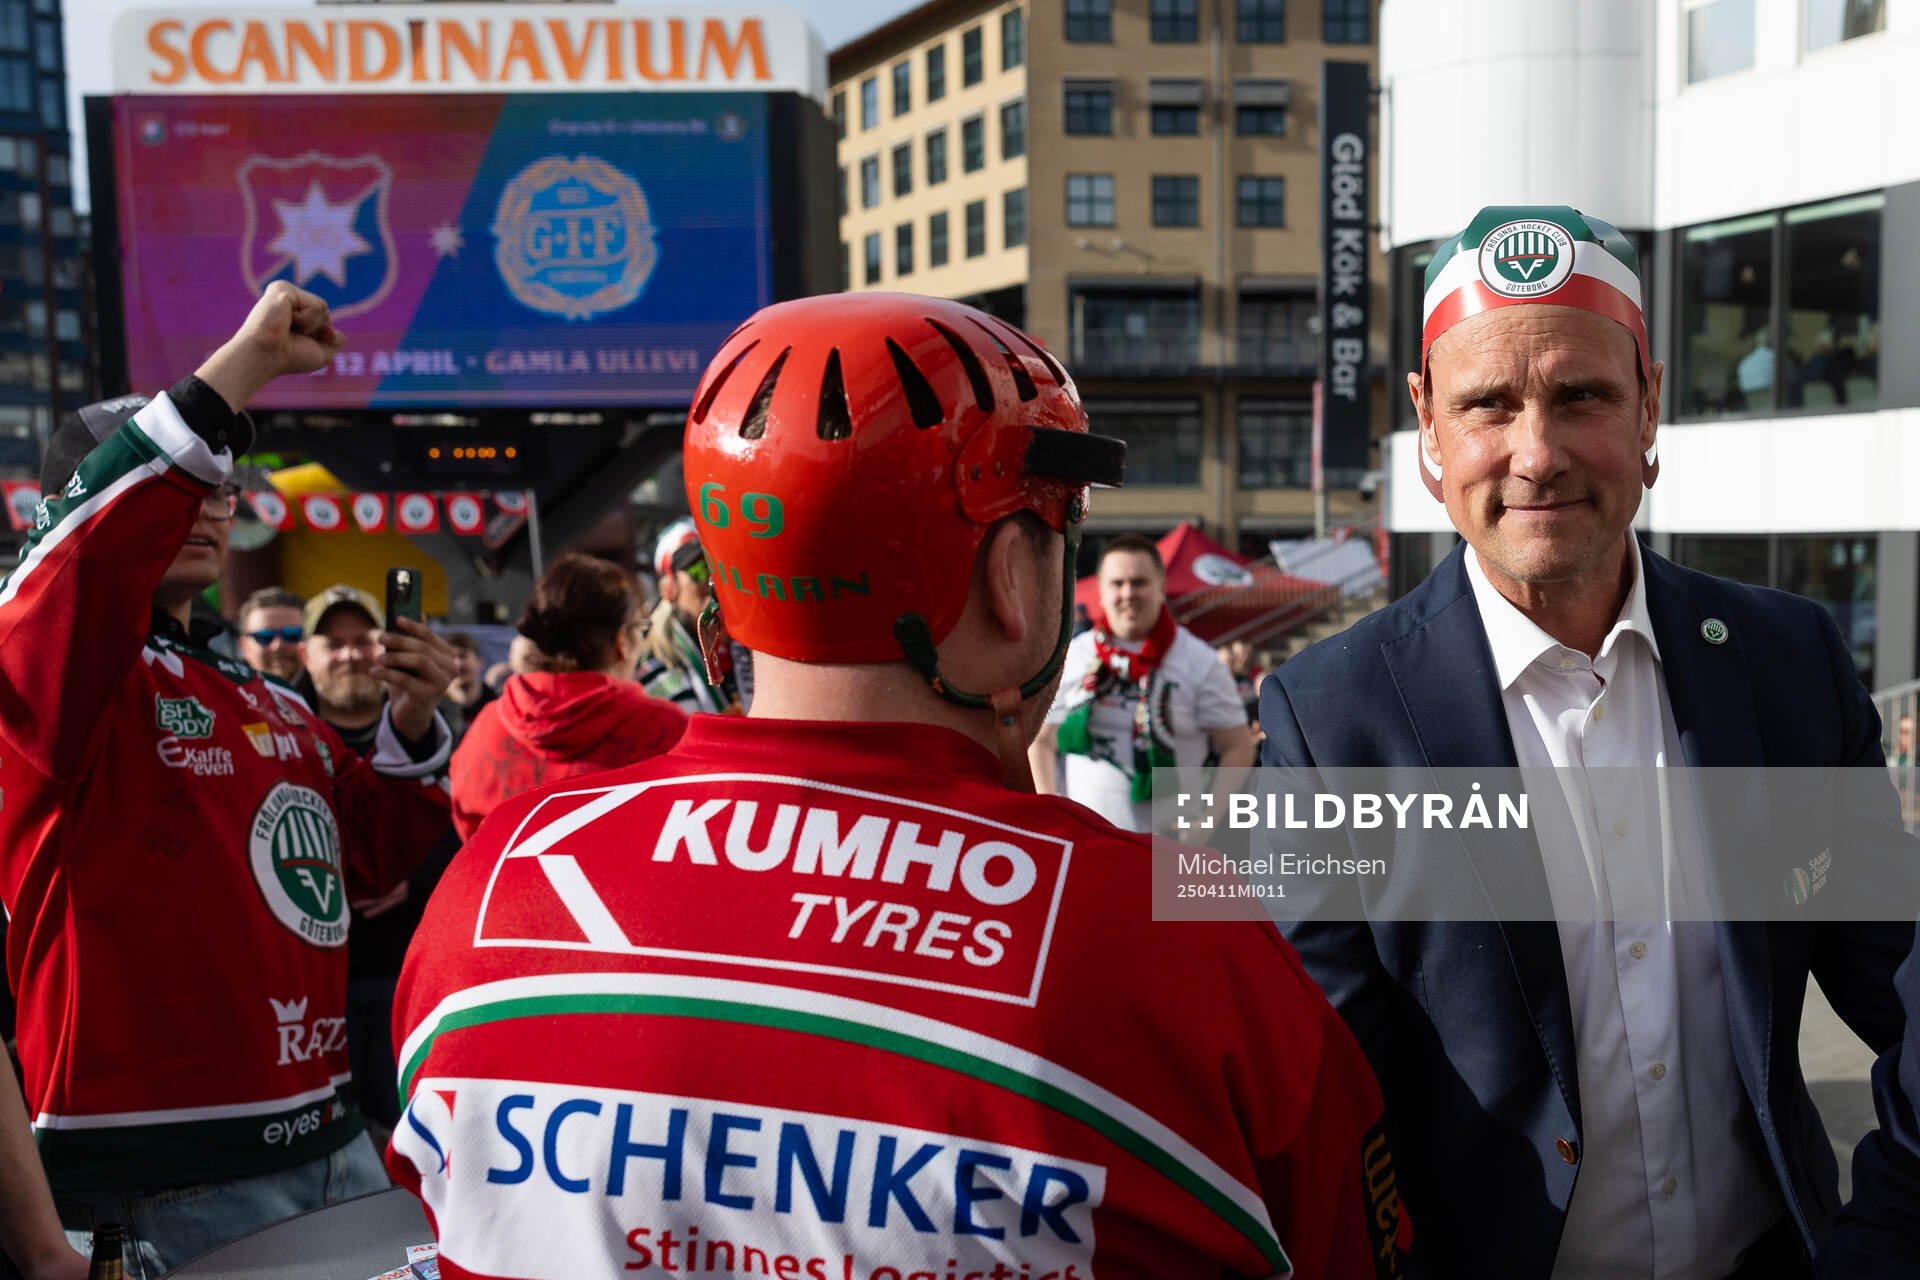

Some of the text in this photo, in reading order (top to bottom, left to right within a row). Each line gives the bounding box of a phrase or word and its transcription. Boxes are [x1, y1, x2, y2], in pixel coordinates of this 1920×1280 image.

[146, 18, 774, 84] SCANDINAVIUM
[1332, 133, 1364, 401] Glöd Kök & Bar
[1486, 223, 1568, 252] FRÖLUNDA HOCKEY CLUB
[1505, 280, 1548, 293] GÖTEBORG
[334, 351, 365, 376] 12
[370, 351, 460, 376] APRIL
[484, 349, 591, 374] GAMLA
[595, 348, 698, 374] ULLEVI
[700, 481, 785, 539] 69
[651, 798, 1038, 906] KUMHO
[787, 892, 1012, 968] TYRES
[487, 1094, 1090, 1245] SCHENKER
[624, 1226, 828, 1280] Stinnes
